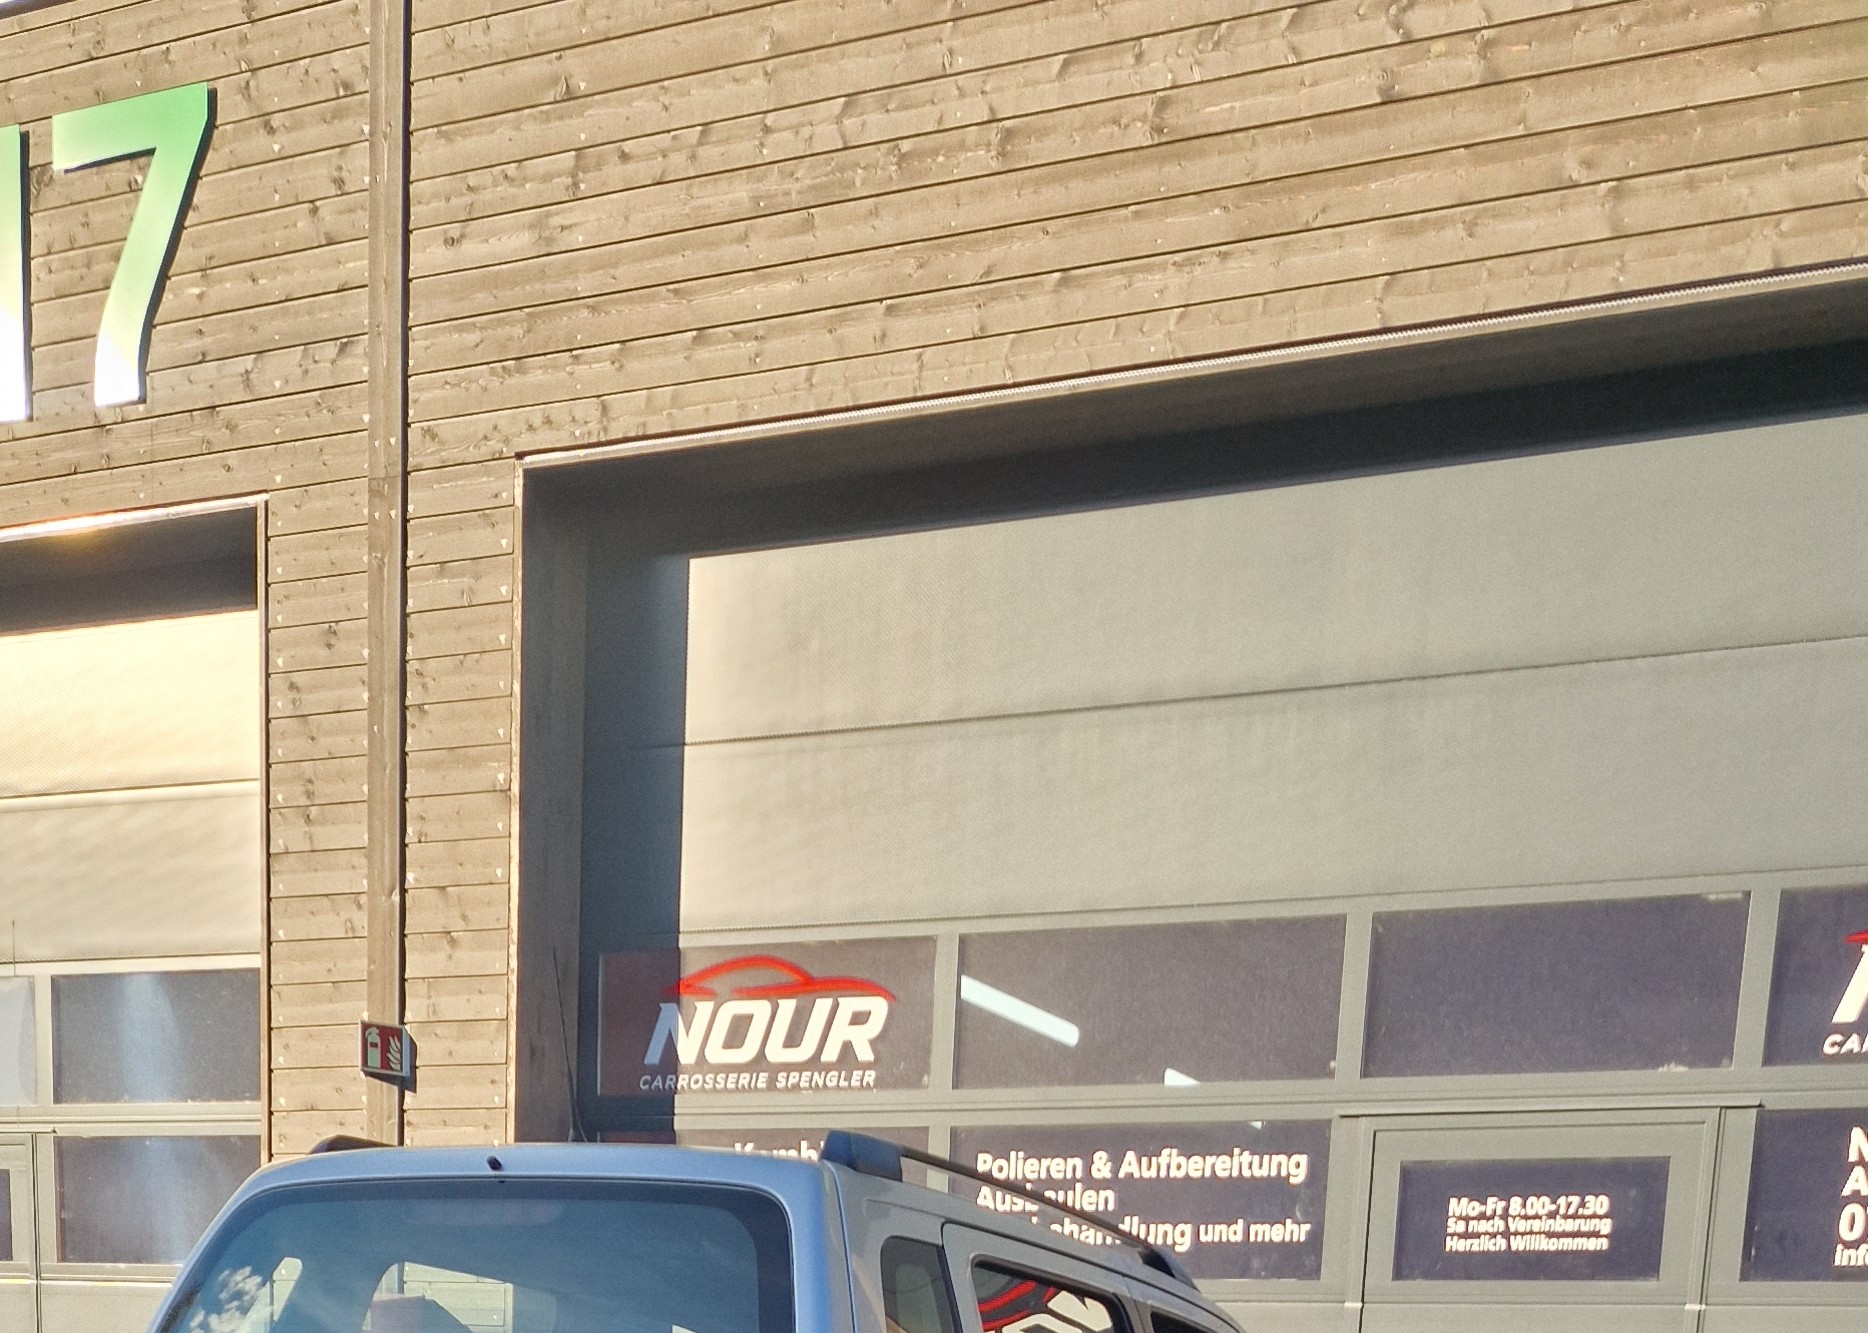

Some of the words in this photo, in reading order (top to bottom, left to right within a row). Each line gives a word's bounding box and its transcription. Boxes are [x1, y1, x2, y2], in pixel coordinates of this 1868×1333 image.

[643, 995, 889, 1066] NOUR
[639, 1072, 769, 1091] CARROSSERIE
[775, 1069, 877, 1090] SPENGLER
[976, 1151, 1083, 1181] Polieren
[1090, 1150, 1112, 1179] &
[1117, 1148, 1308, 1185] Aufbereitung
[1448, 1196, 1506, 1217] Mo-Fr
[1508, 1195, 1610, 1216] 8.00-17.30
[1198, 1218, 1244, 1243] und
[1249, 1218, 1312, 1243] mehr
[1447, 1217, 1466, 1233] Sa
[1467, 1216, 1505, 1233] nach
[1507, 1215, 1612, 1235] Vereinbarung
[1445, 1235, 1507, 1252] Herzlich
[1509, 1234, 1609, 1251] Willkommen
